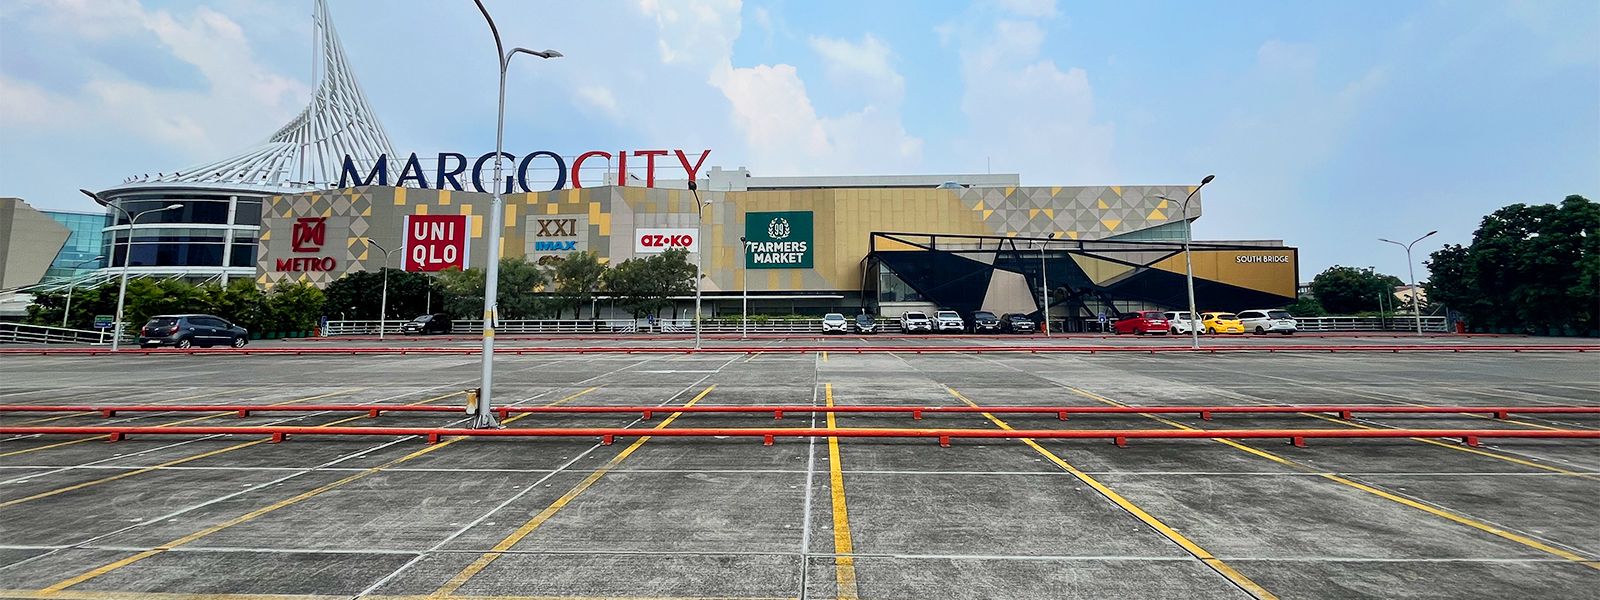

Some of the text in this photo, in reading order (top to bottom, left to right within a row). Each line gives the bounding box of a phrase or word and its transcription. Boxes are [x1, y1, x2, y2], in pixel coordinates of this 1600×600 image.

[414, 222, 454, 240] UNI
[536, 219, 577, 237] XXI
[774, 223, 784, 236] 99
[535, 241, 577, 251] IMAX
[751, 241, 807, 253] FARMERS
[413, 245, 457, 267] QLO
[753, 252, 804, 264] MARKET
[1236, 255, 1289, 263] SOUTH BRIDGE
[276, 256, 336, 272] METRO
